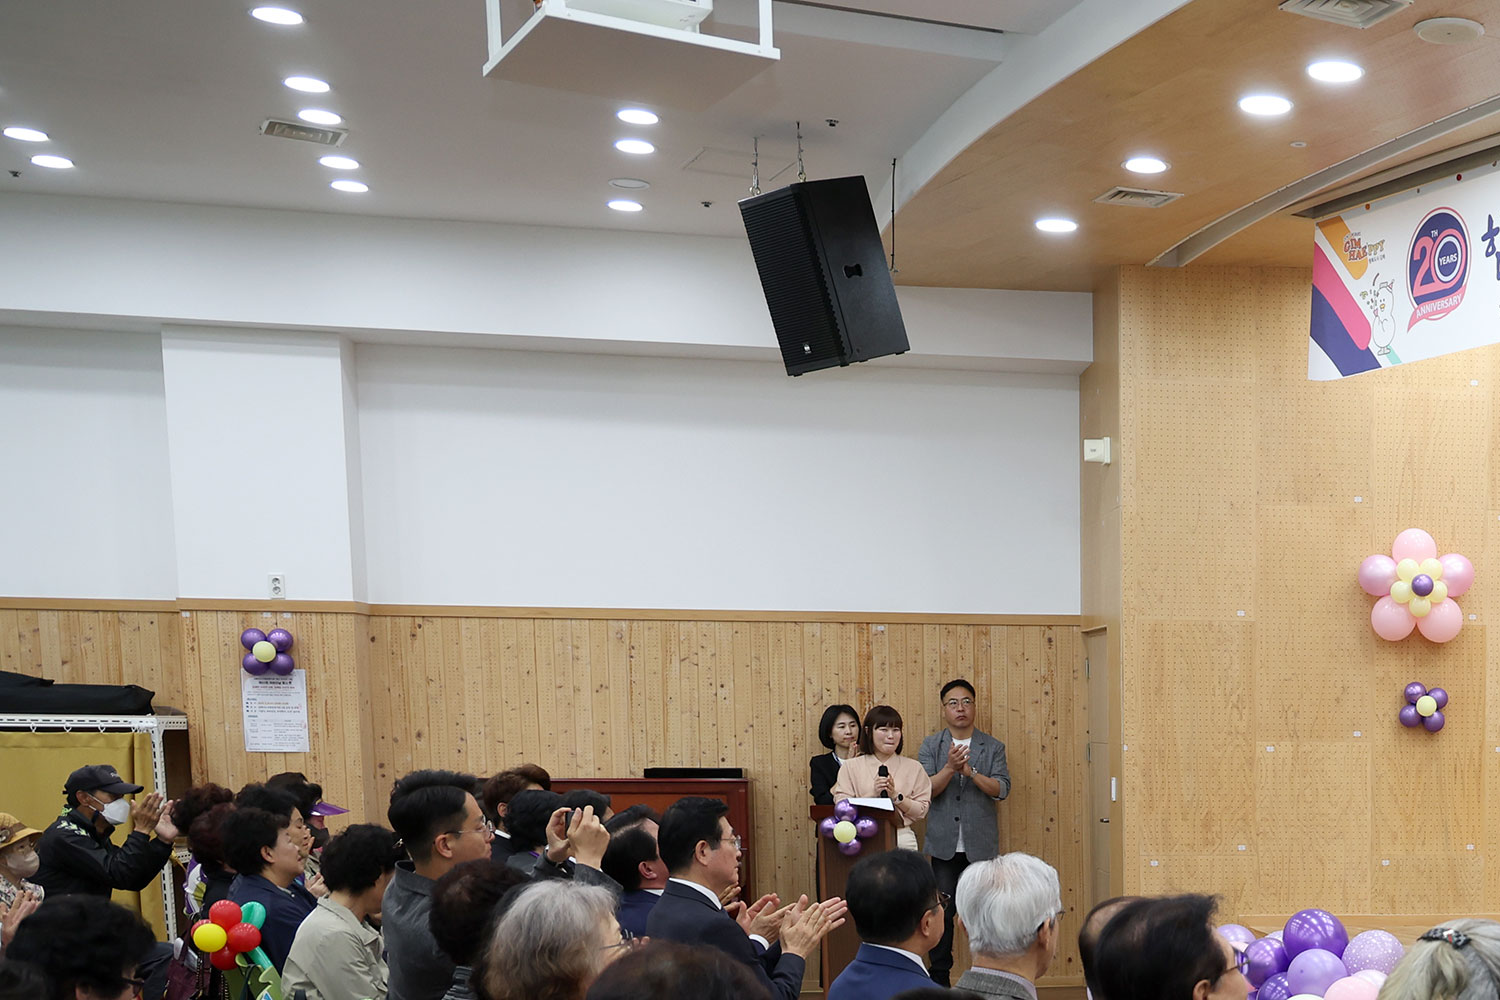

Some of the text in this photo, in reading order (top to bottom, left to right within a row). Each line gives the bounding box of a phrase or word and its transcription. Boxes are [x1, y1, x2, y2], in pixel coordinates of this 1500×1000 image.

[1431, 229, 1439, 238] TH
[1439, 253, 1458, 266] YEARS
[1416, 294, 1462, 319] ANNIVERSARY
